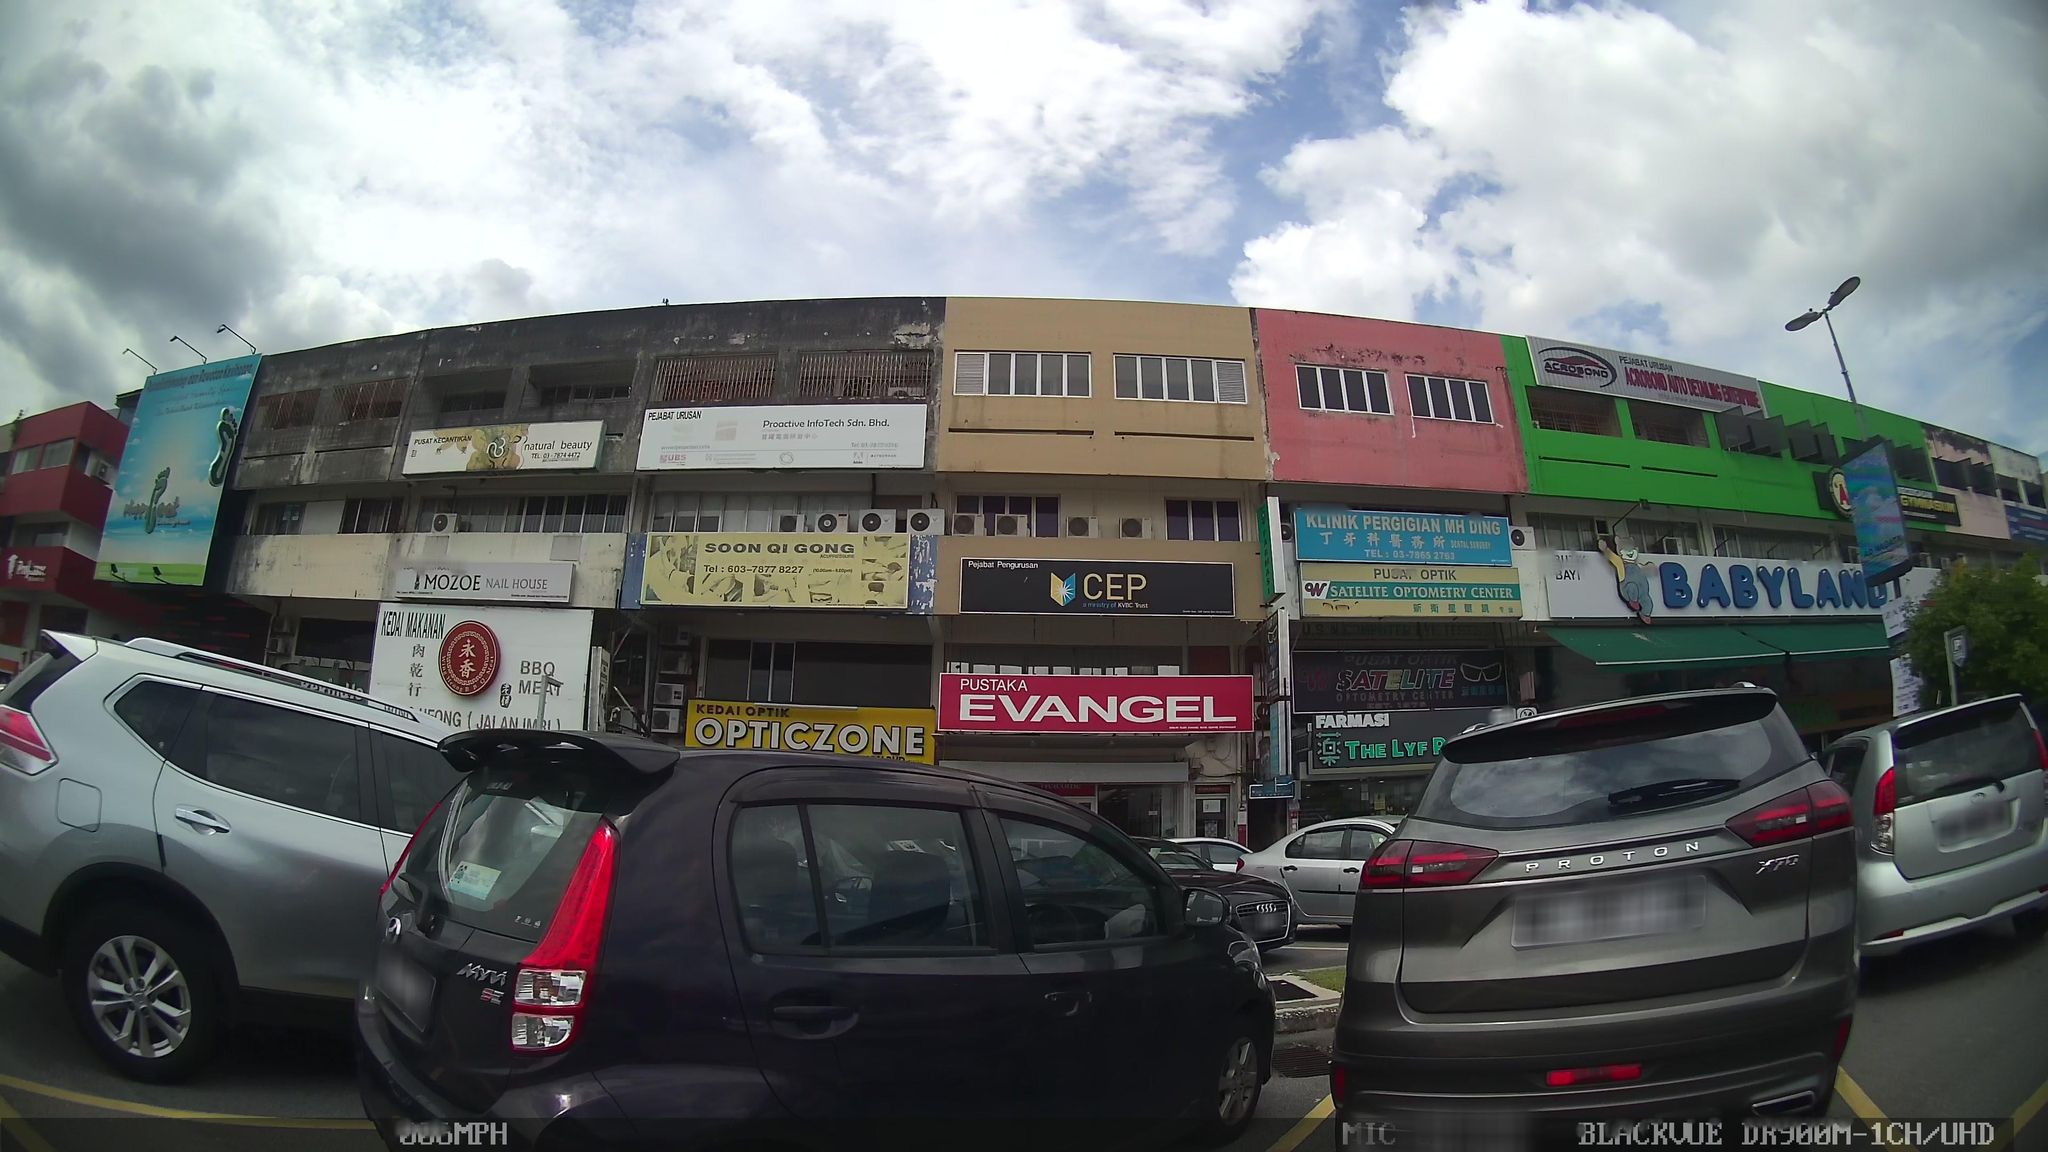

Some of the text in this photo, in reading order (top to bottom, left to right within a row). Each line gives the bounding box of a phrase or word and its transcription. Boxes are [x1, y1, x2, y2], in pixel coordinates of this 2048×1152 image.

[1545, 362, 1608, 378] ACROBOND
[1624, 366, 1668, 391] ACROBOND
[1668, 374, 1688, 394] AUTO
[648, 411, 702, 421] PEJABAT URUSAN
[763, 420, 804, 428] Proactive
[807, 419, 844, 427] InfoTech
[847, 419, 866, 427] Sdn.
[433, 436, 472, 444] KECANTIKAN
[524, 441, 592, 451] natural beauty
[1307, 514, 1501, 536] KLINIK PERGIGIAN MH DING
[704, 543, 855, 554] SOON QI GONG
[704, 565, 717, 573] Tel
[779, 566, 804, 574] 8227
[968, 561, 1038, 570] Pejabat Pengurusan
[424, 574, 547, 590] MOZOE NAIL HOUSE
[1421, 570, 1457, 580] OPTIK
[1083, 573, 1147, 601] CEP
[1330, 586, 1387, 597] SATELITE
[1393, 587, 1466, 598] OPTOMETRY
[1471, 588, 1513, 598] CENTER
[381, 610, 447, 640] KEDAI MAKANAN
[459, 638, 476, 679] 永香
[520, 661, 555, 677] BBQ
[960, 679, 1027, 692] PUSTAKA
[1336, 669, 1455, 691] SATELITE
[696, 704, 790, 718] KEDAI OPTIK
[960, 694, 1237, 723] EVANGEL
[1316, 713, 1390, 729] FARMASI
[695, 718, 924, 755] OPTICZONE
[1525, 841, 1699, 873] PROTON
